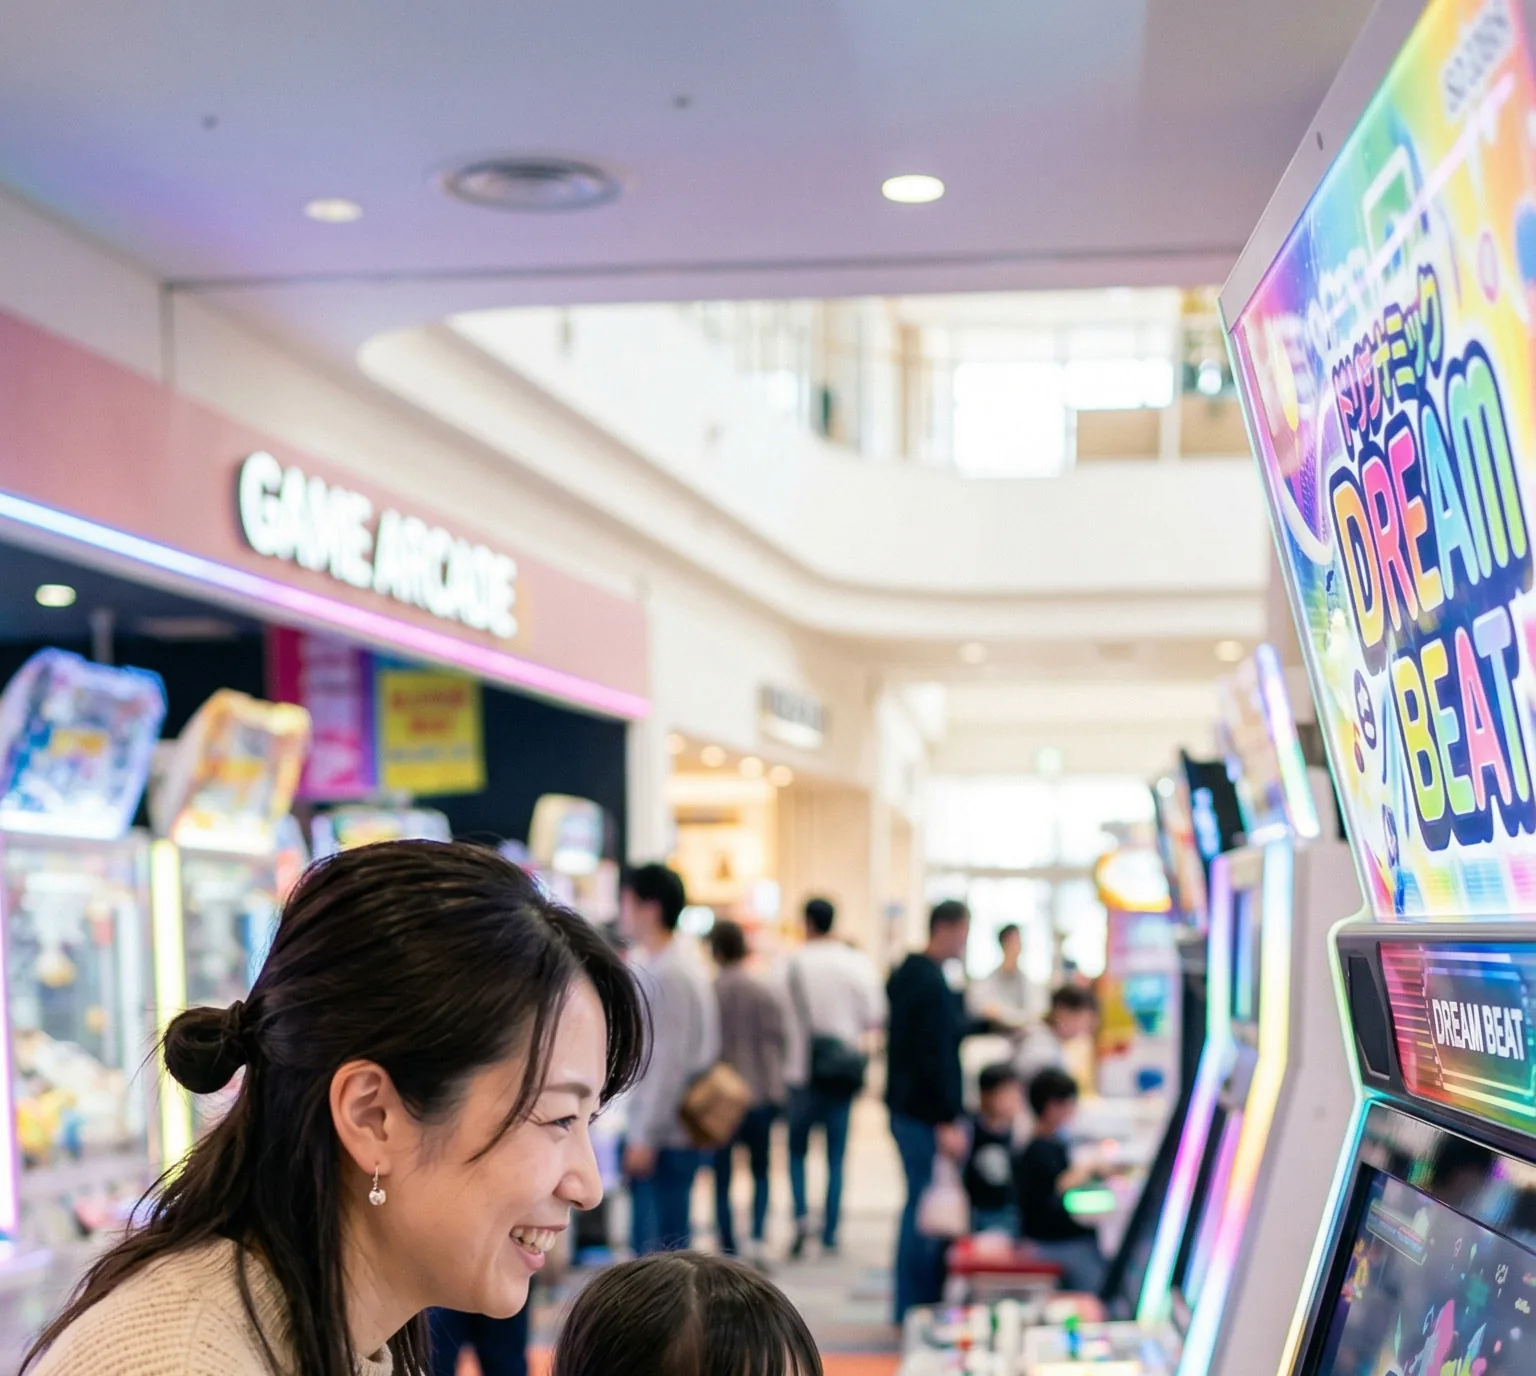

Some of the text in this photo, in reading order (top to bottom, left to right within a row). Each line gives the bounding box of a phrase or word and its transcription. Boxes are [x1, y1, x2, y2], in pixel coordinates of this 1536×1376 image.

[239, 450, 517, 638] GAME ARCADE
[1330, 345, 1528, 652] DREAM
[1390, 605, 1532, 826] BEAT
[1432, 999, 1525, 1061] DREAM BEAT
